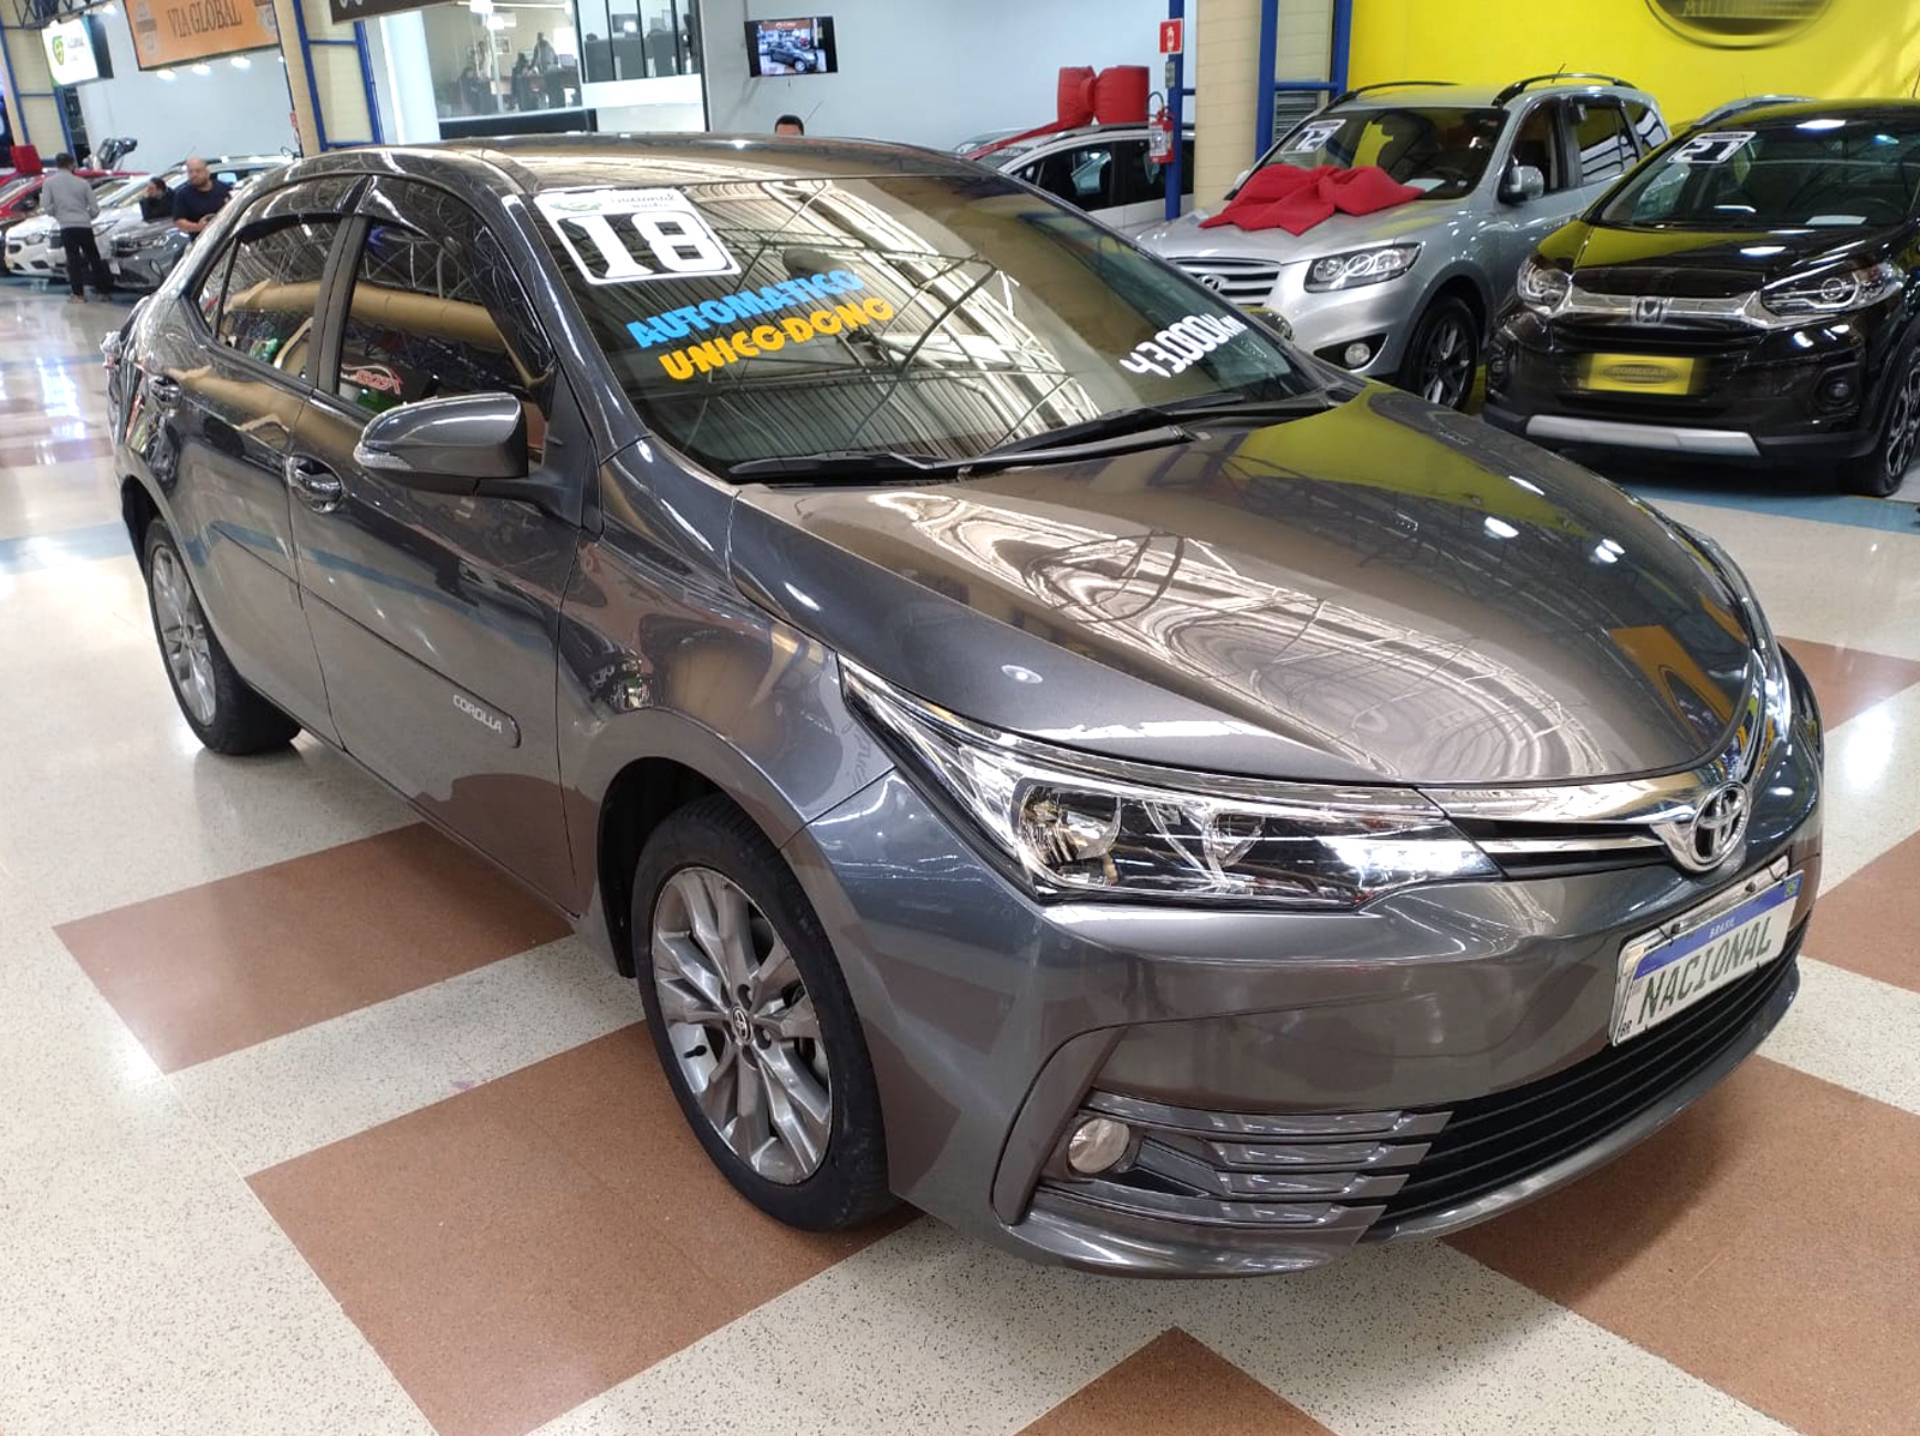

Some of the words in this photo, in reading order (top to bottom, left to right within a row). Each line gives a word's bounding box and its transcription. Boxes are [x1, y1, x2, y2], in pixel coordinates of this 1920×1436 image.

[167, 8, 192, 39] VIA
[189, 0, 242, 34] GLOBAL
[566, 210, 729, 280] 18
[626, 269, 867, 349] AUTOMATICO
[452, 693, 503, 733] COROLLA
[1637, 916, 1774, 1025] NACIONAL
